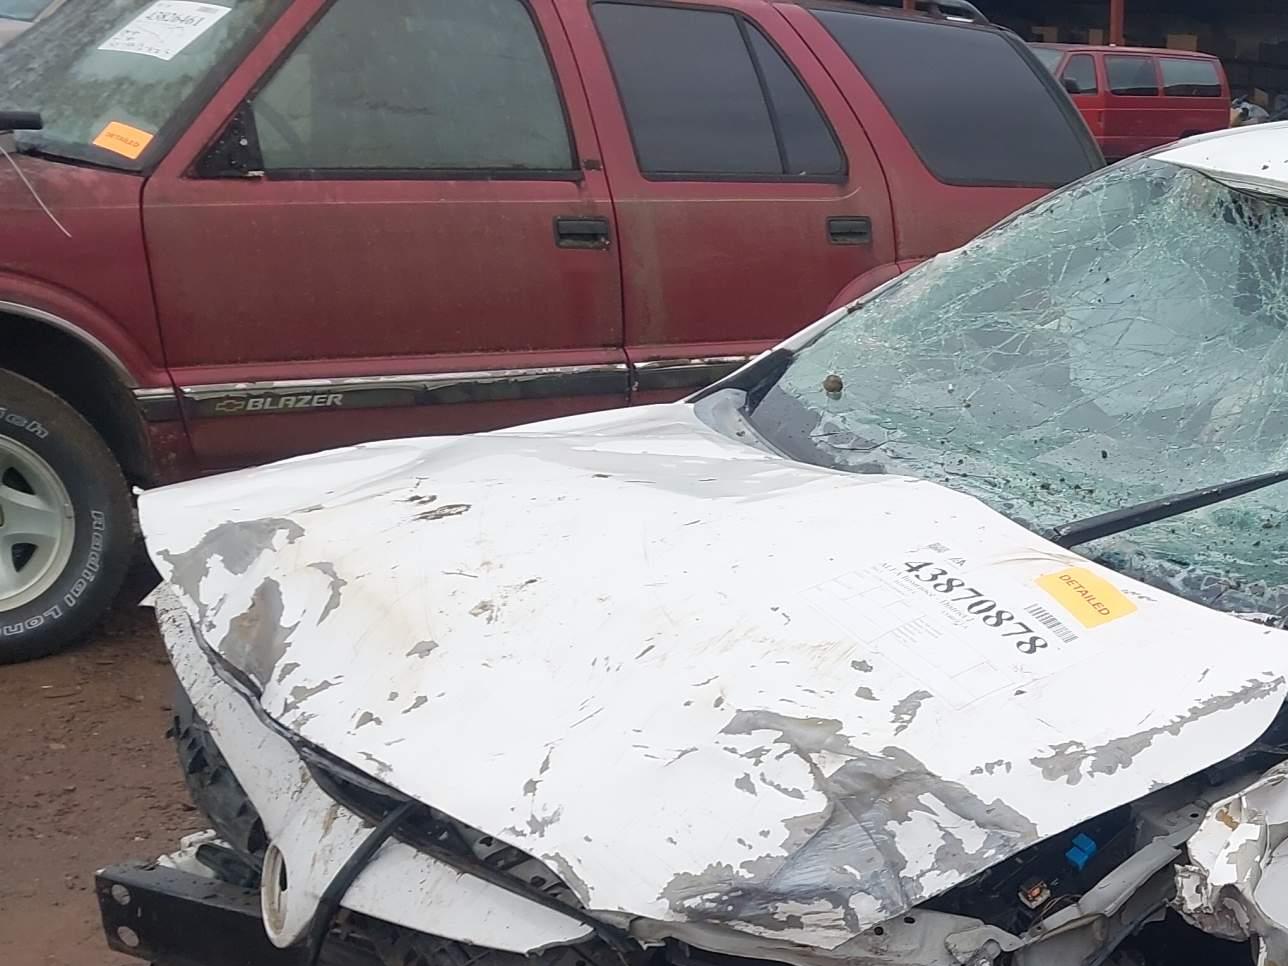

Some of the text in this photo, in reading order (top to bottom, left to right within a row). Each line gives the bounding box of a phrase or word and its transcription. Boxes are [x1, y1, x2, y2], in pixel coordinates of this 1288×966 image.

[246, 394, 343, 411] BLAZER
[903, 561, 1049, 656] 43870878
[1058, 574, 1111, 617] DETAILED
[0, 609, 63, 637] Lon
